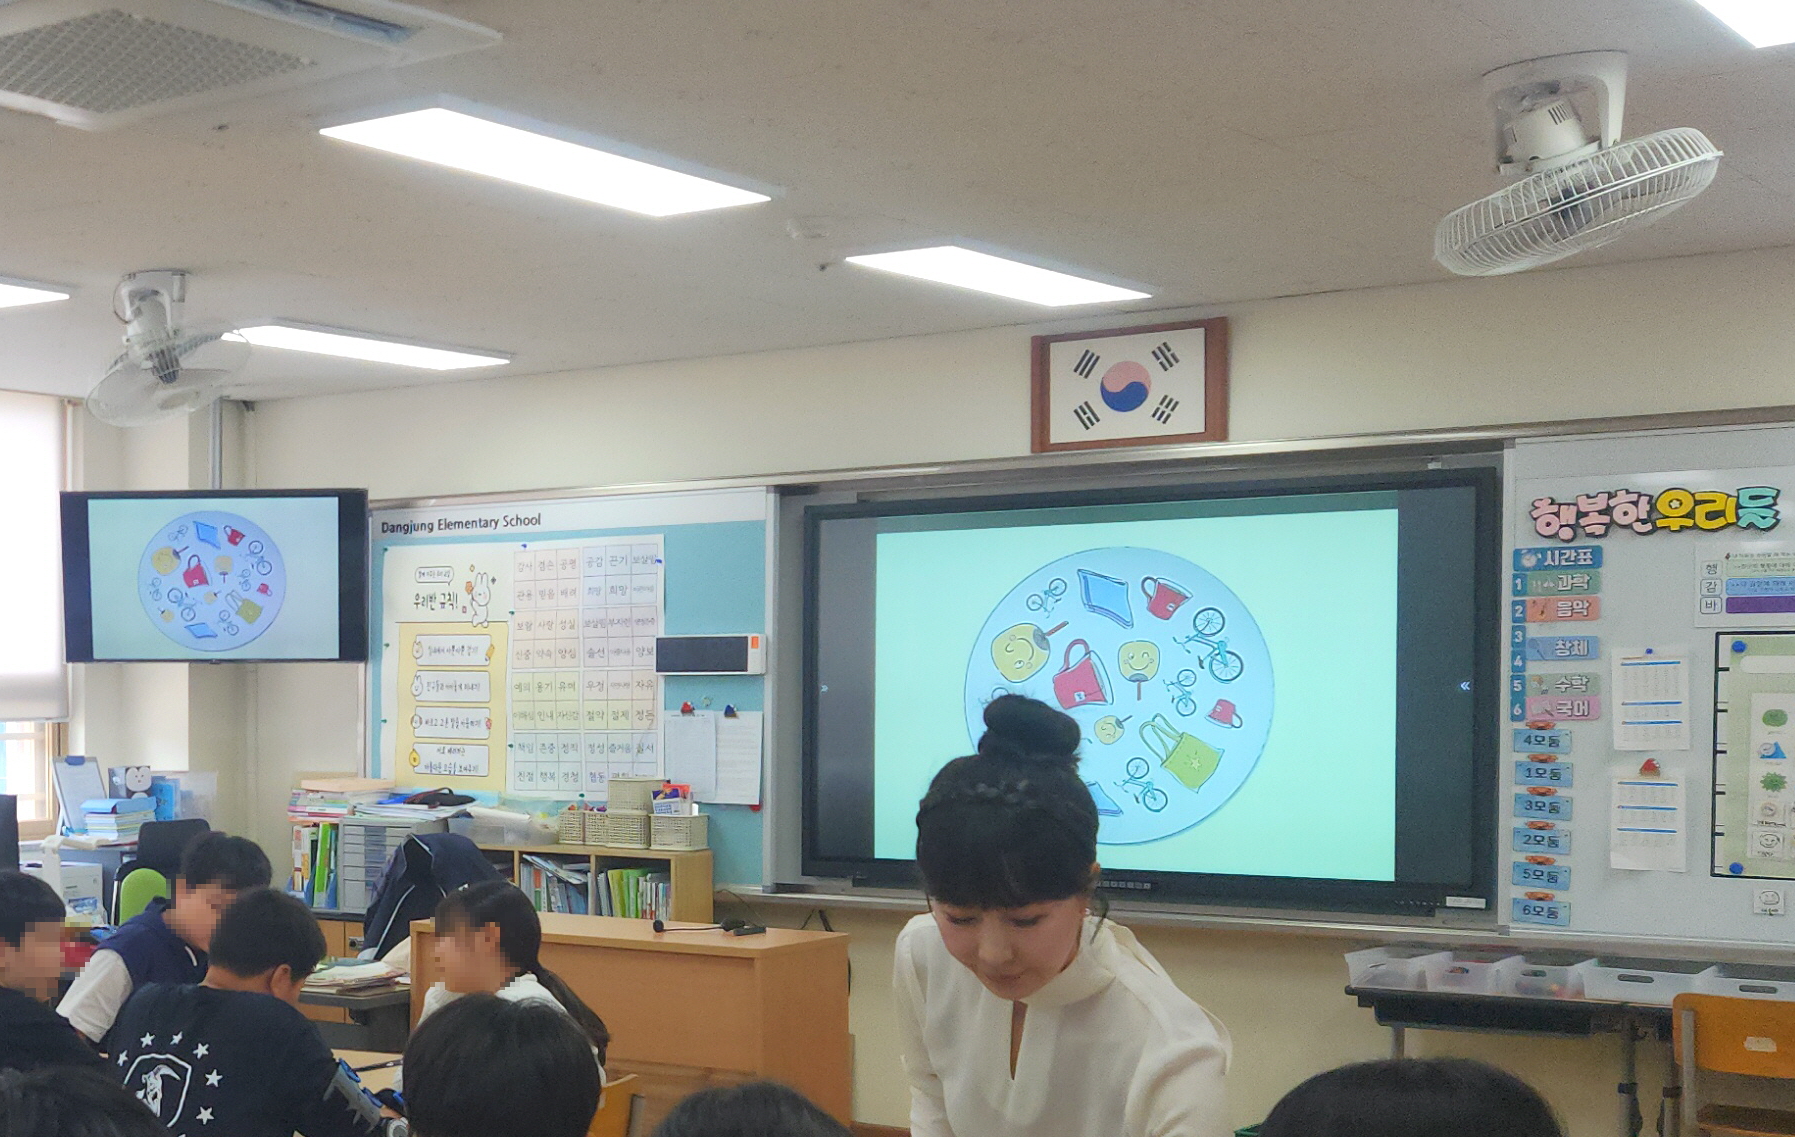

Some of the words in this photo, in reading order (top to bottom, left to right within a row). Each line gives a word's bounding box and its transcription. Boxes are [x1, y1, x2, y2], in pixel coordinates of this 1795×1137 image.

[1531, 489, 1655, 543] 행복한
[1656, 486, 1781, 532] 우리들
[381, 520, 434, 534] Dangjung
[437, 518, 499, 531] Elementary
[503, 513, 541, 527] School
[1543, 549, 1593, 566] 시간표
[1516, 578, 1523, 590] 1
[1557, 574, 1590, 591] 과학
[414, 592, 437, 611] 우리반
[440, 591, 458, 611] 규칙!
[1515, 605, 1524, 617] 2
[1557, 600, 1590, 617] 음악
[1706, 599, 1717, 611] 바
[1515, 631, 1523, 643] 3
[1555, 639, 1588, 657] 창체
[1514, 655, 1523, 667] 4
[1513, 680, 1522, 692] 5
[1555, 675, 1588, 692] 수학
[1514, 704, 1522, 716] 6
[1556, 701, 1590, 717] 국어
[1524, 733, 1561, 748] 4모둠
[1525, 768, 1561, 781] 1모둠
[1524, 800, 1561, 814] 3모둠
[1523, 834, 1560, 849] 2모둠
[1523, 868, 1559, 884] 5모둠
[1522, 905, 1559, 921] 6모둠
